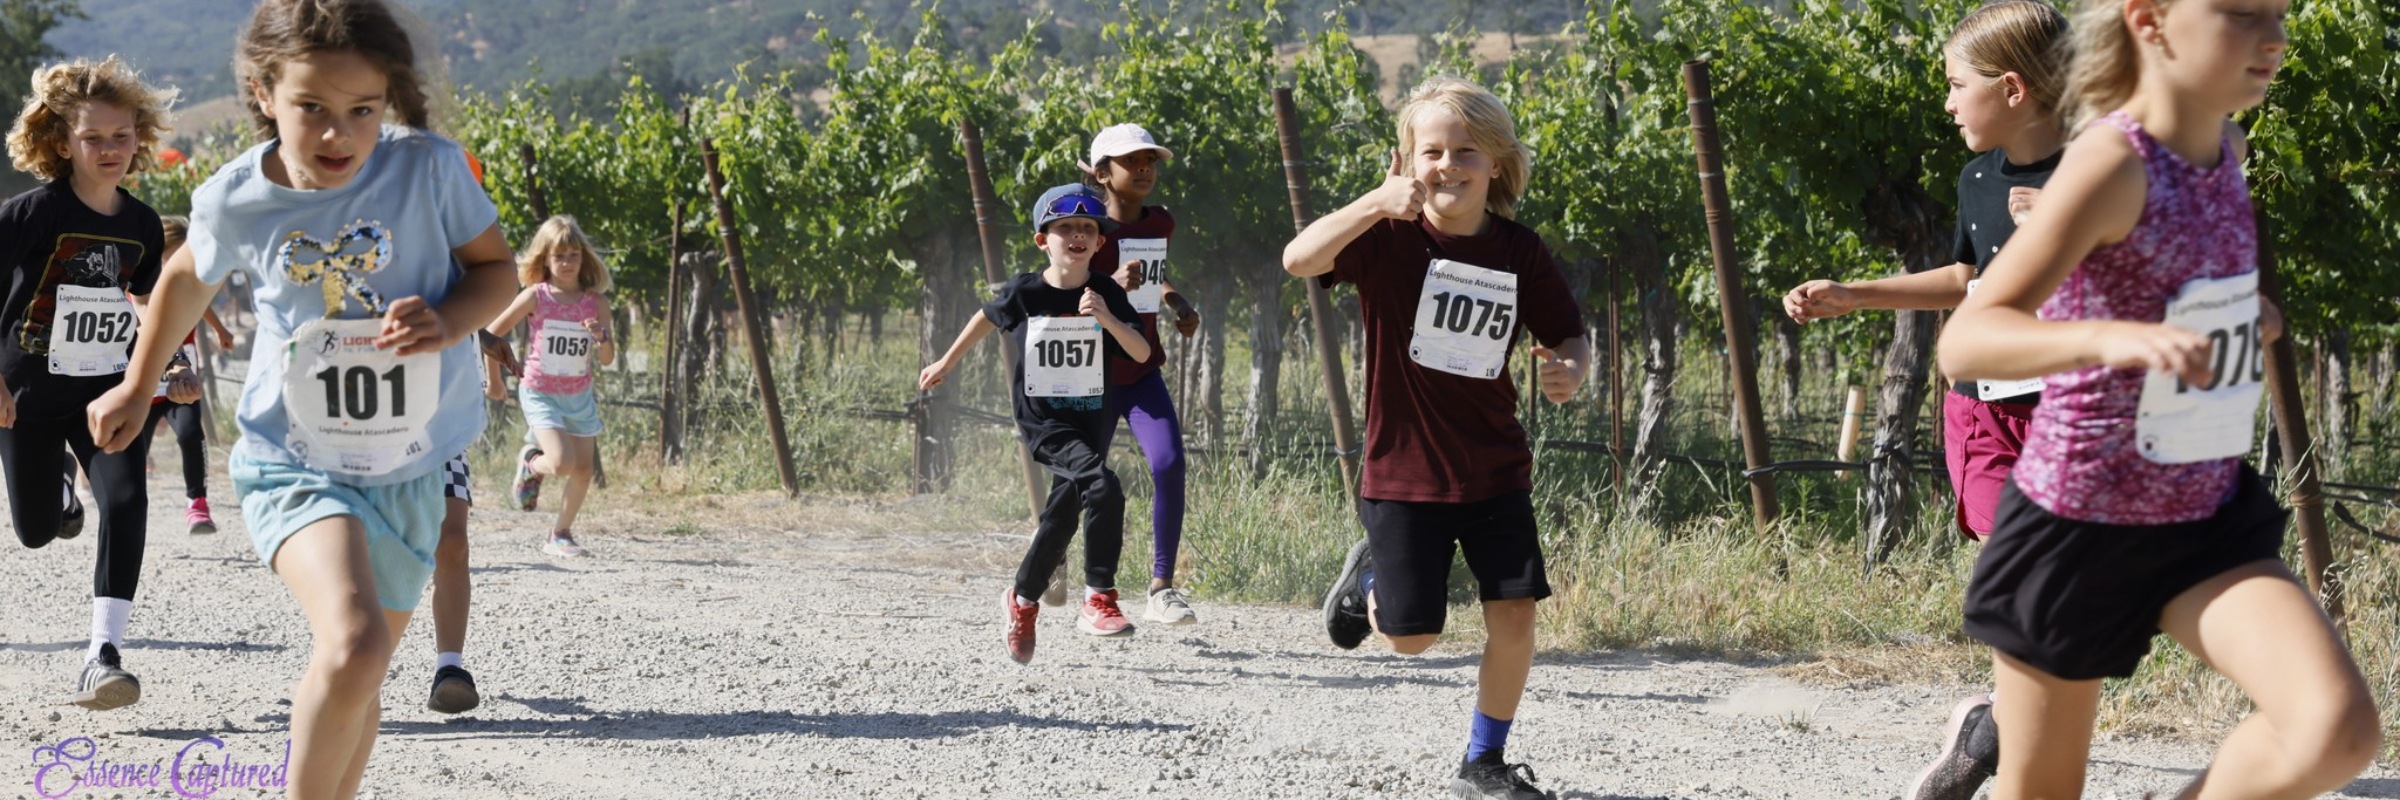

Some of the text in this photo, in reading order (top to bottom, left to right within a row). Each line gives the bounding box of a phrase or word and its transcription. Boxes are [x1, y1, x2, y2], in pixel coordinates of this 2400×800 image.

[1430, 269, 1474, 285] Lighthouse
[59, 294, 98, 303] Lighthouse
[63, 311, 132, 343] 1052
[1432, 291, 1513, 341] 1075
[547, 335, 589, 356] 1053
[1035, 339, 1096, 368] 1057
[316, 363, 405, 420] 101
[406, 441, 421, 456] 101
